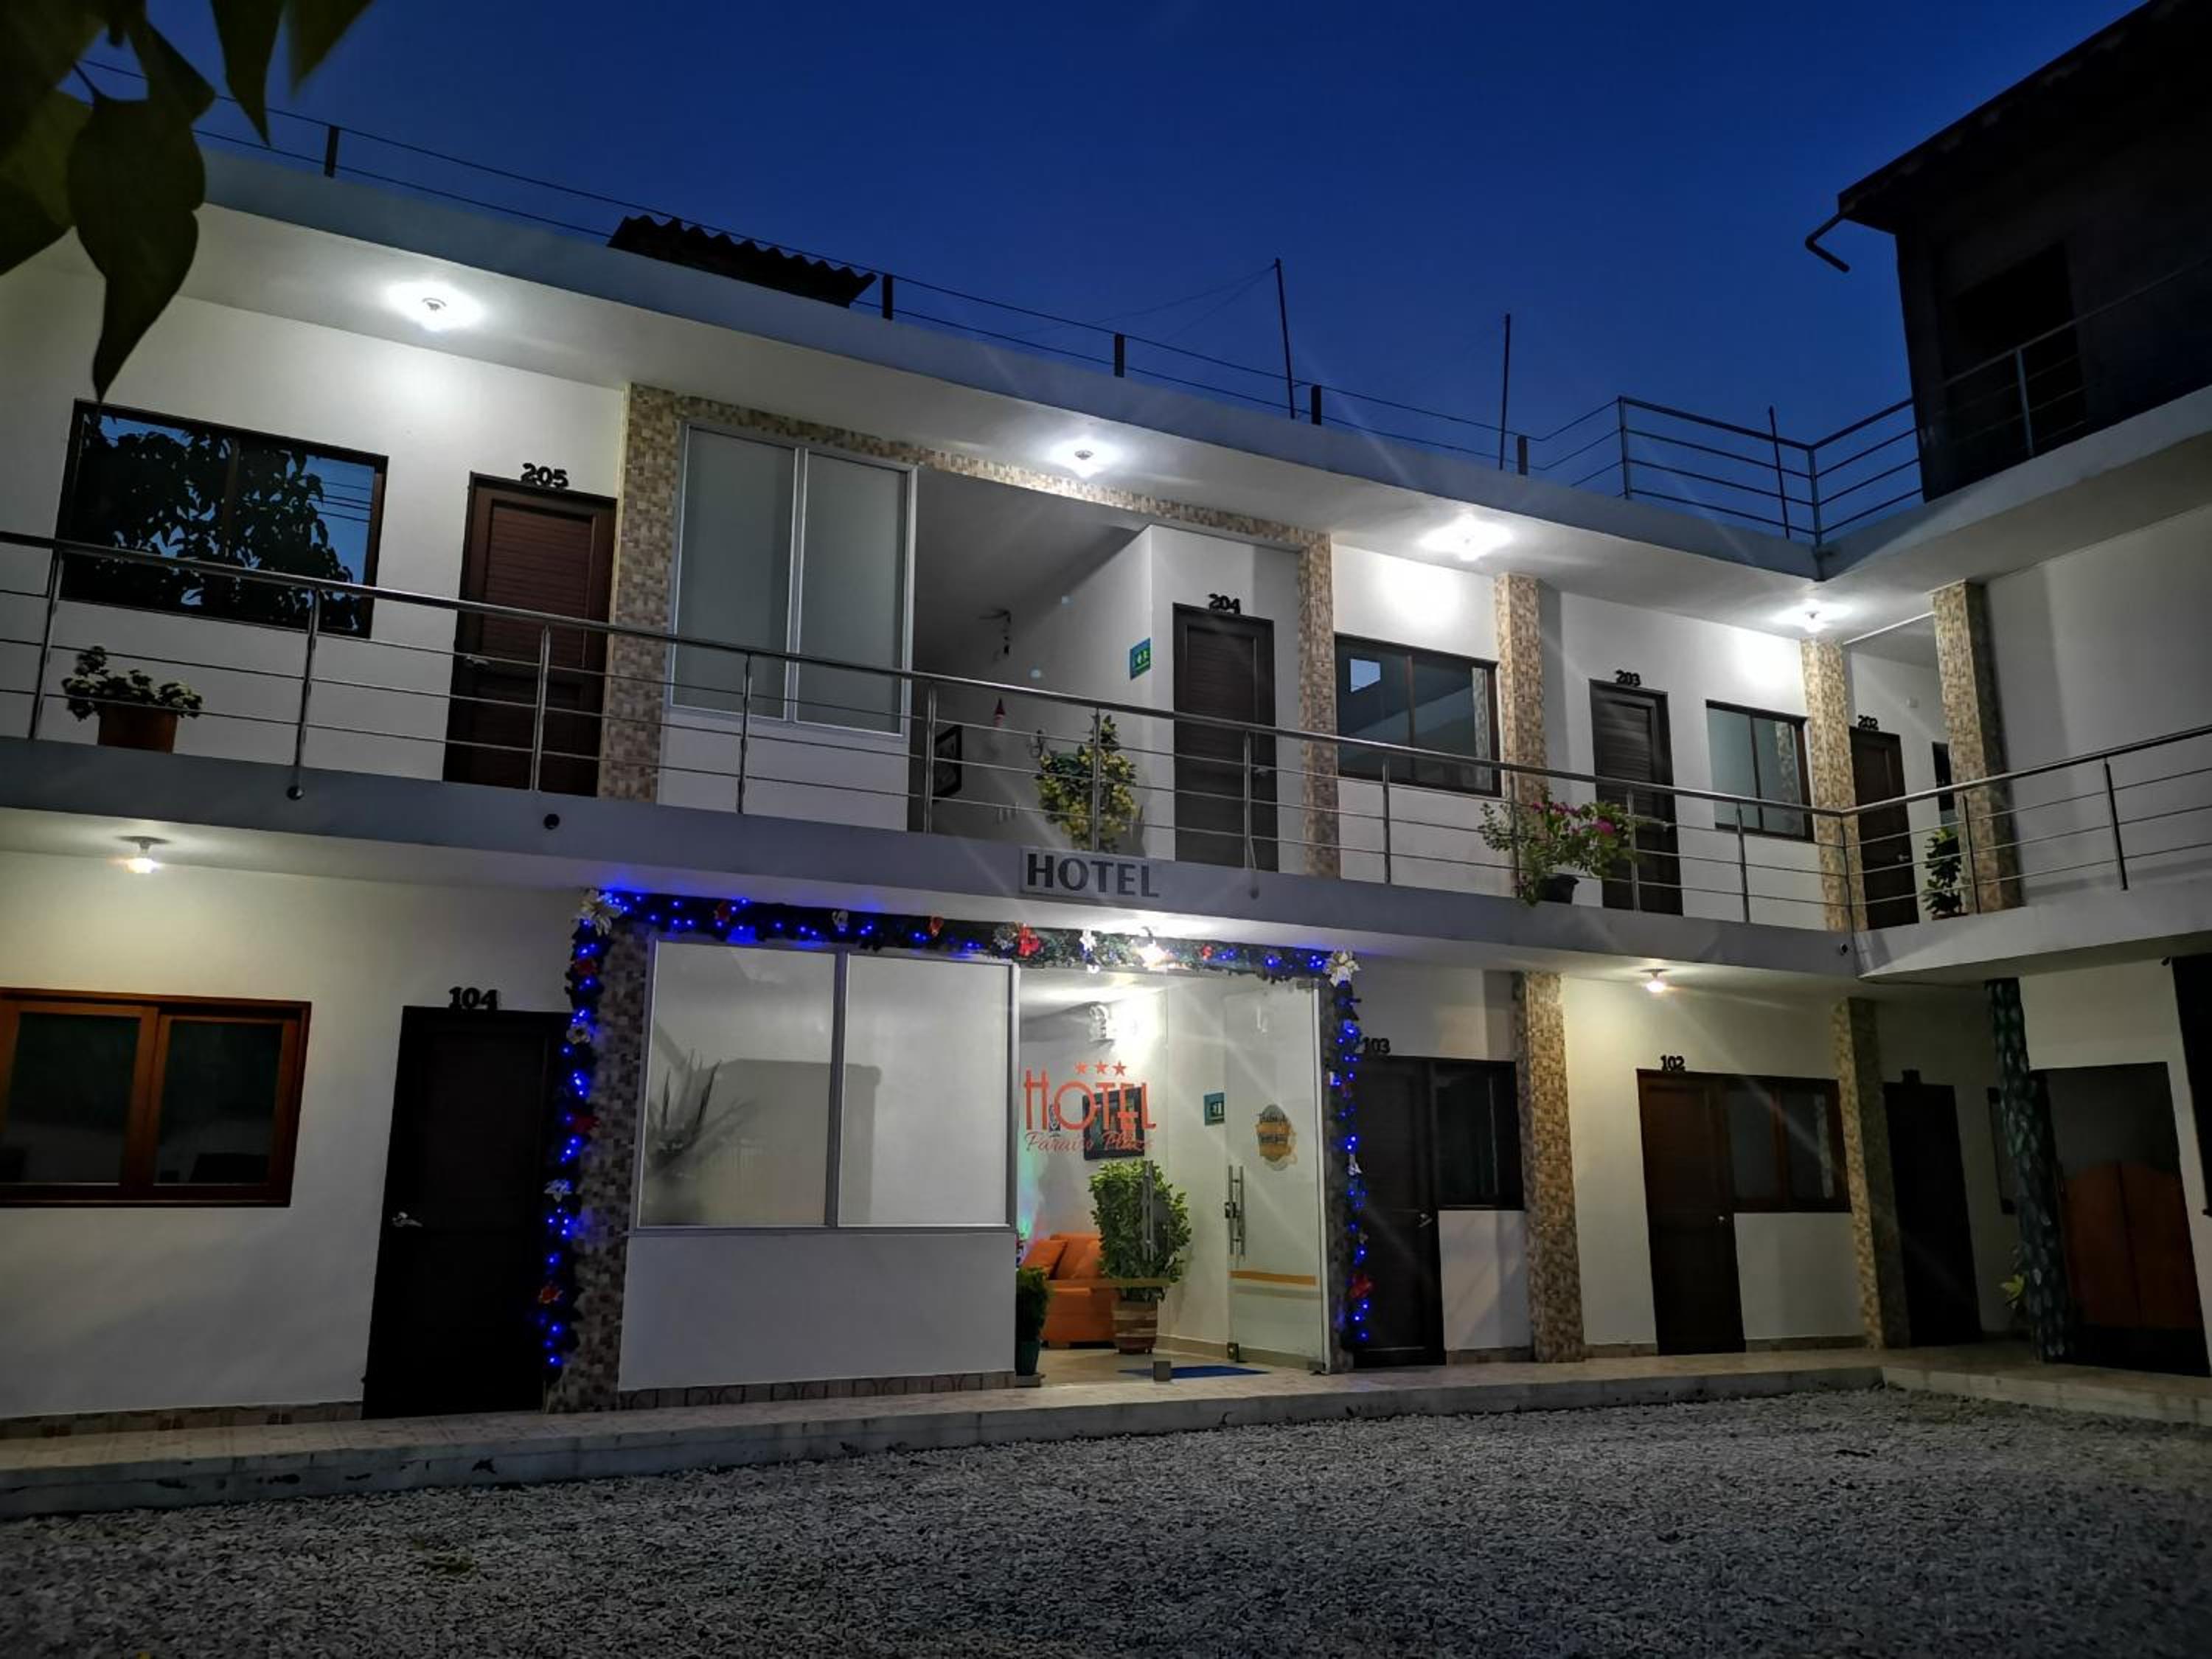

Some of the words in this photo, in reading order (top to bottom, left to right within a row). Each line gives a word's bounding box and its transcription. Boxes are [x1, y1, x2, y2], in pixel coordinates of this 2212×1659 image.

[521, 462, 569, 488] 205
[1208, 593, 1241, 614] 204
[1615, 669, 1641, 687] 203
[1027, 853, 1160, 898] HOTEL
[448, 986, 498, 1010] 104
[1660, 1054, 1686, 1071] 102
[1023, 1066, 1157, 1130] HOTEL
